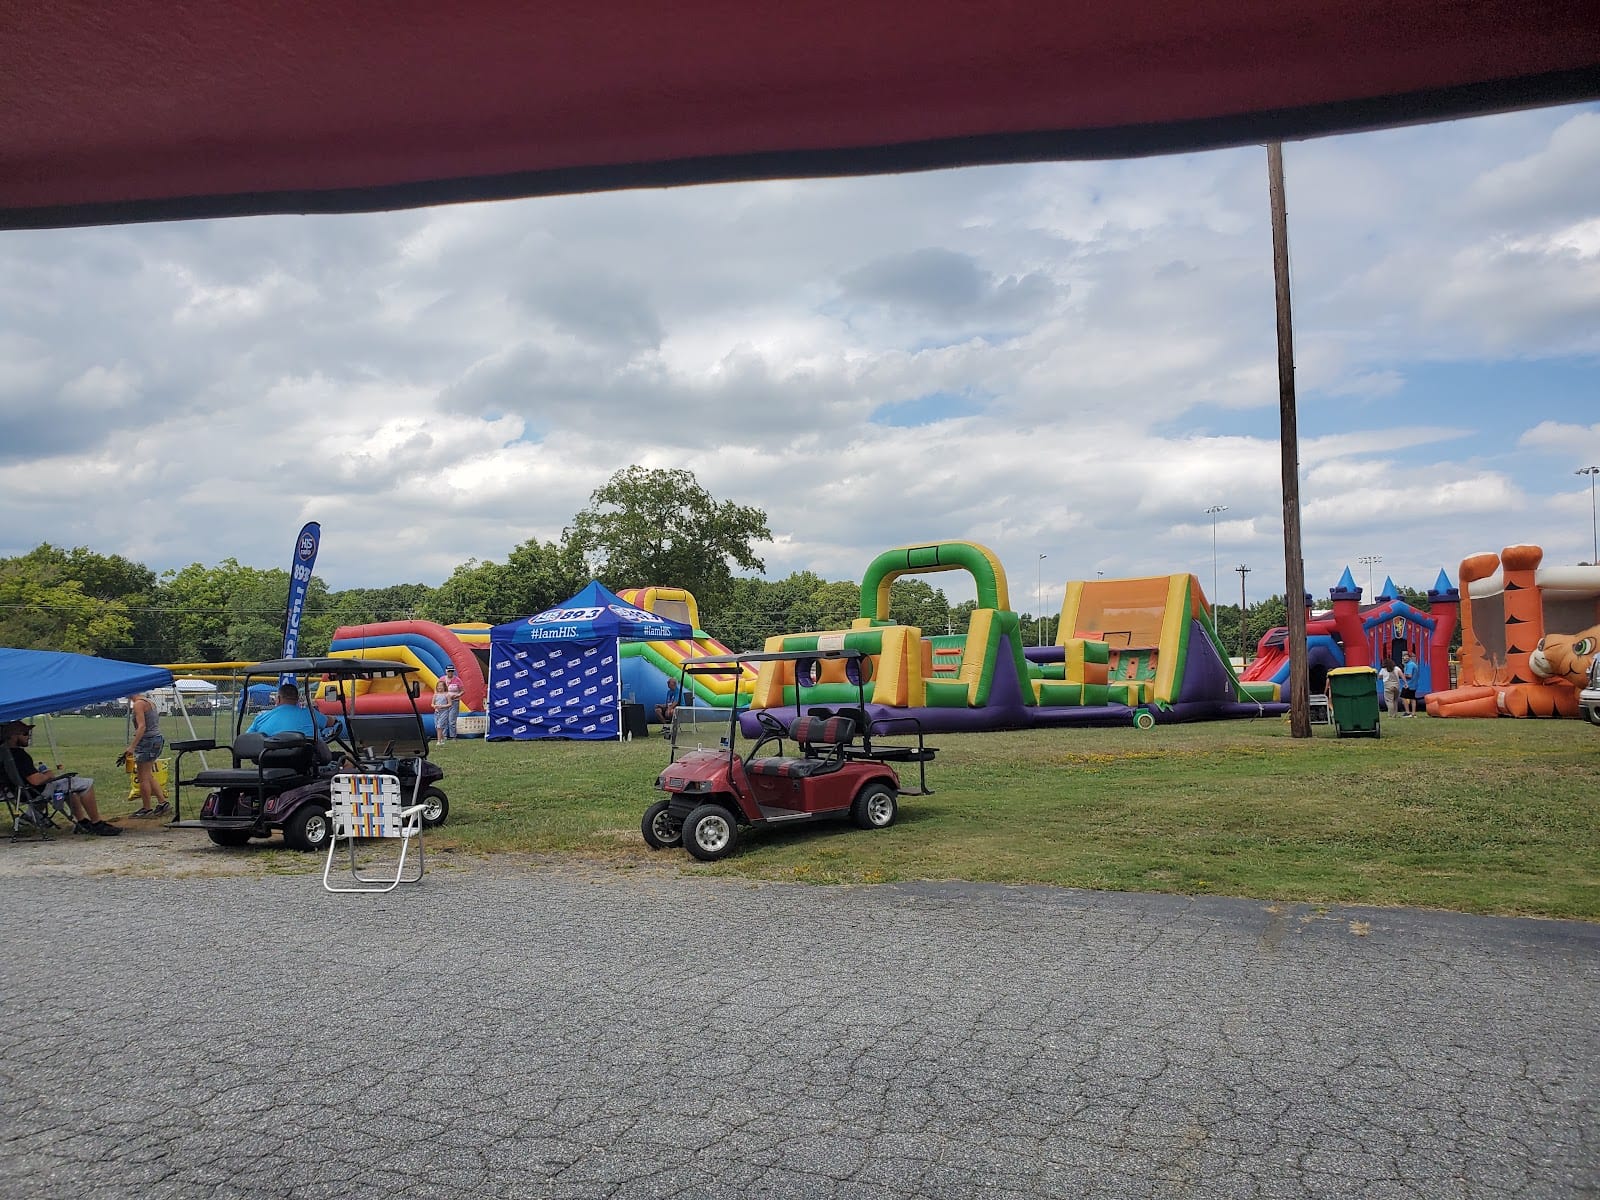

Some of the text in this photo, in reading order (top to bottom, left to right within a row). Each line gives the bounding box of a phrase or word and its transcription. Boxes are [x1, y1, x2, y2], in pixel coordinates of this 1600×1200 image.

[301, 538, 313, 548] HIS
[560, 610, 600, 619] 89.3
[531, 626, 579, 640] #IamHIS.
